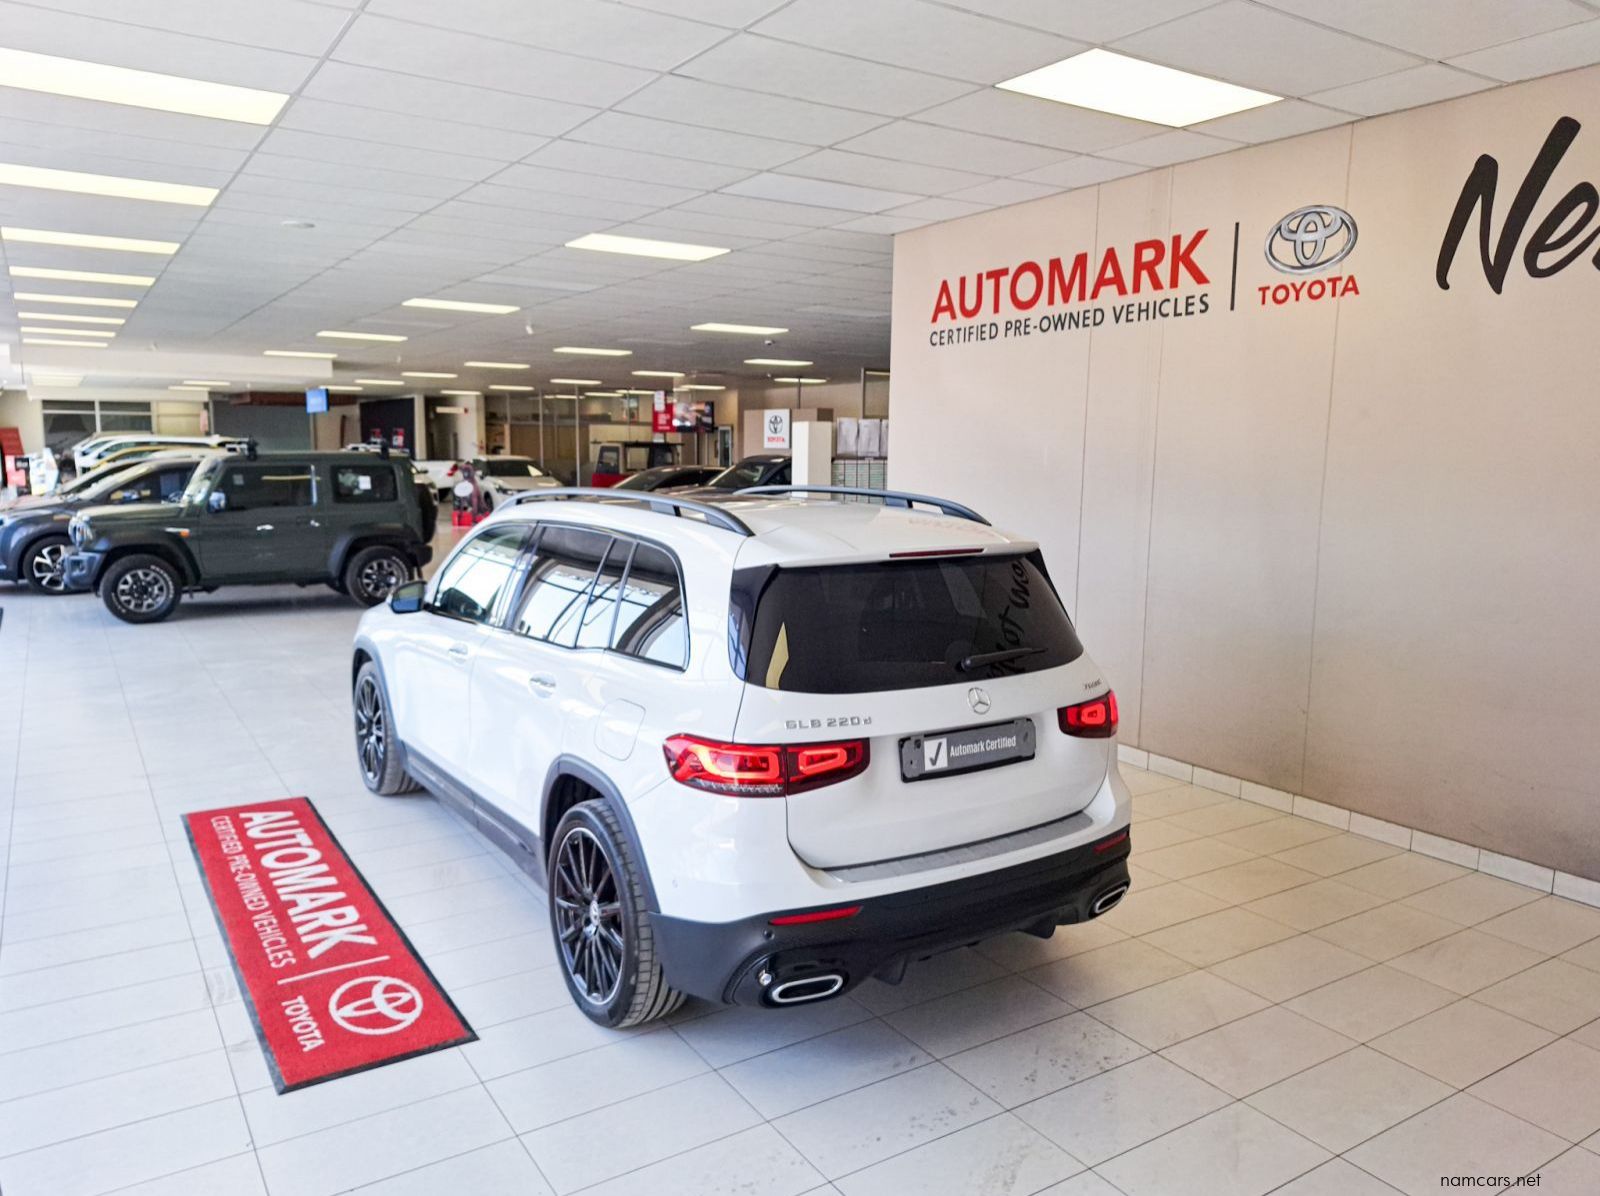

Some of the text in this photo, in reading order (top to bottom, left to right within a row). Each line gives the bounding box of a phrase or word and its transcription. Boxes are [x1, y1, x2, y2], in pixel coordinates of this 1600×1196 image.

[1436, 116, 1600, 295] Ne
[931, 228, 1210, 324] AUTOMARK
[1258, 274, 1360, 306] TOYOTA
[929, 293, 1210, 347] CERTIFIED PRE-OWNED VEHICLES
[950, 734, 1017, 758] Automark Certified
[211, 815, 297, 969] CERTIFIED PRE-OWNED VEHICLES
[239, 811, 378, 959] AUTOMARK
[281, 995, 325, 1052] TOYOTA
